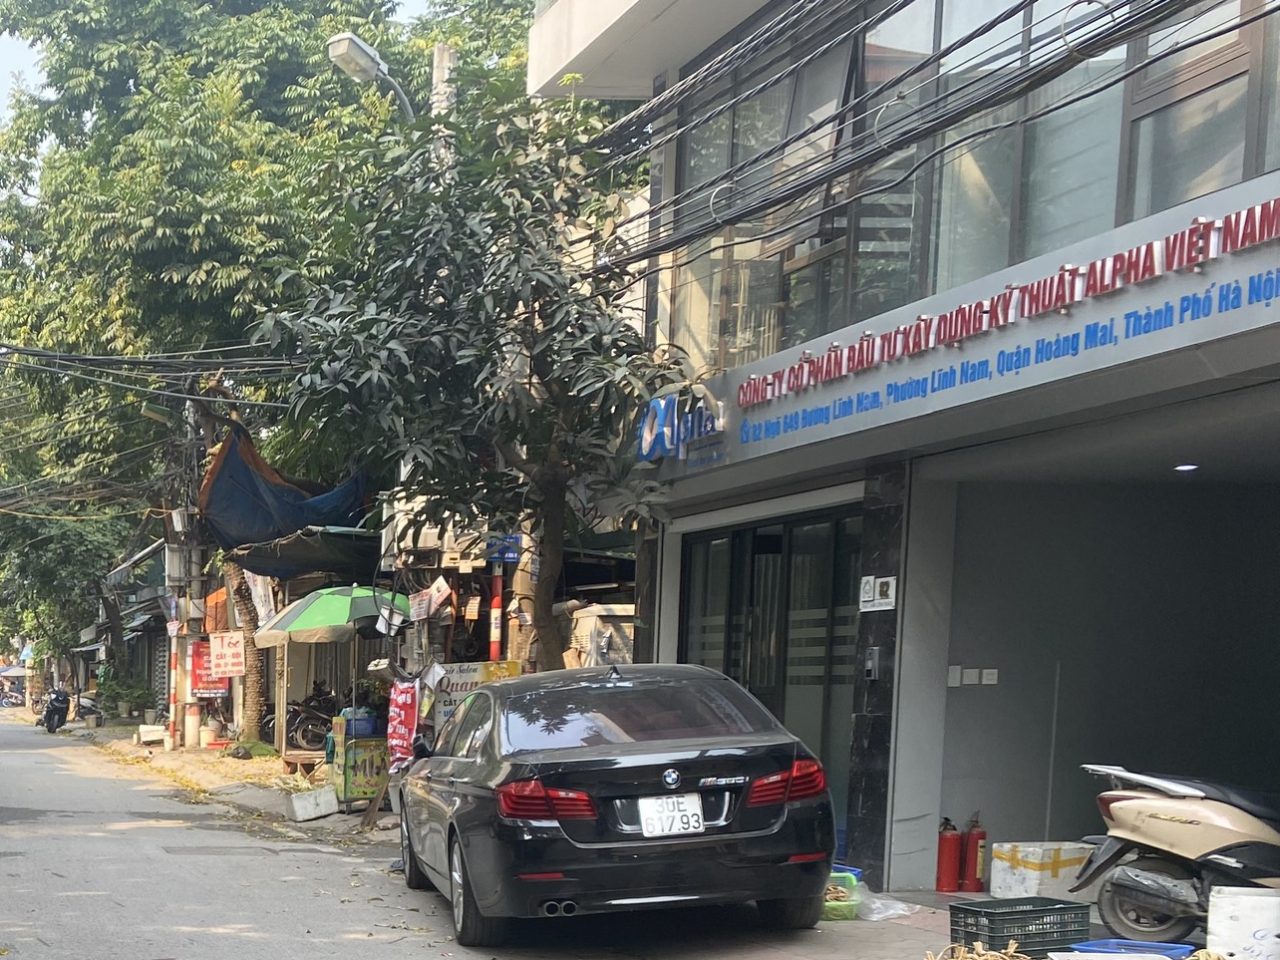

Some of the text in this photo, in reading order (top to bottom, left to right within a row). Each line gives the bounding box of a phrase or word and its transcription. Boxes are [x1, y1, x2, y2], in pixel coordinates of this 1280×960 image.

[737, 374, 769, 409] CÔNG
[771, 368, 787, 398] TY
[807, 341, 844, 386] PHẦN
[880, 326, 905, 362] TƯ
[903, 314, 936, 356] XÂY
[937, 301, 986, 348] DỰNG
[988, 283, 1019, 329] KỸ
[1019, 264, 1082, 318] THUẬT
[1084, 241, 1160, 298] ALPHA
[1165, 217, 1218, 273] VIỆT
[1221, 196, 1280, 254] NAM
[833, 397, 854, 420] Lĩnh
[886, 376, 929, 404] Phường
[930, 365, 957, 393] Lĩnh
[960, 359, 992, 385] Nam,
[996, 344, 1032, 376] Quận
[1034, 331, 1081, 365] Hoàng
[1084, 317, 1119, 350] Mai,
[1123, 302, 1174, 340] Thành
[1179, 281, 1217, 324] Phố
[1217, 279, 1242, 313] Hà
[645, 812, 701, 834] 617.93
[655, 794, 688, 814] 30E
